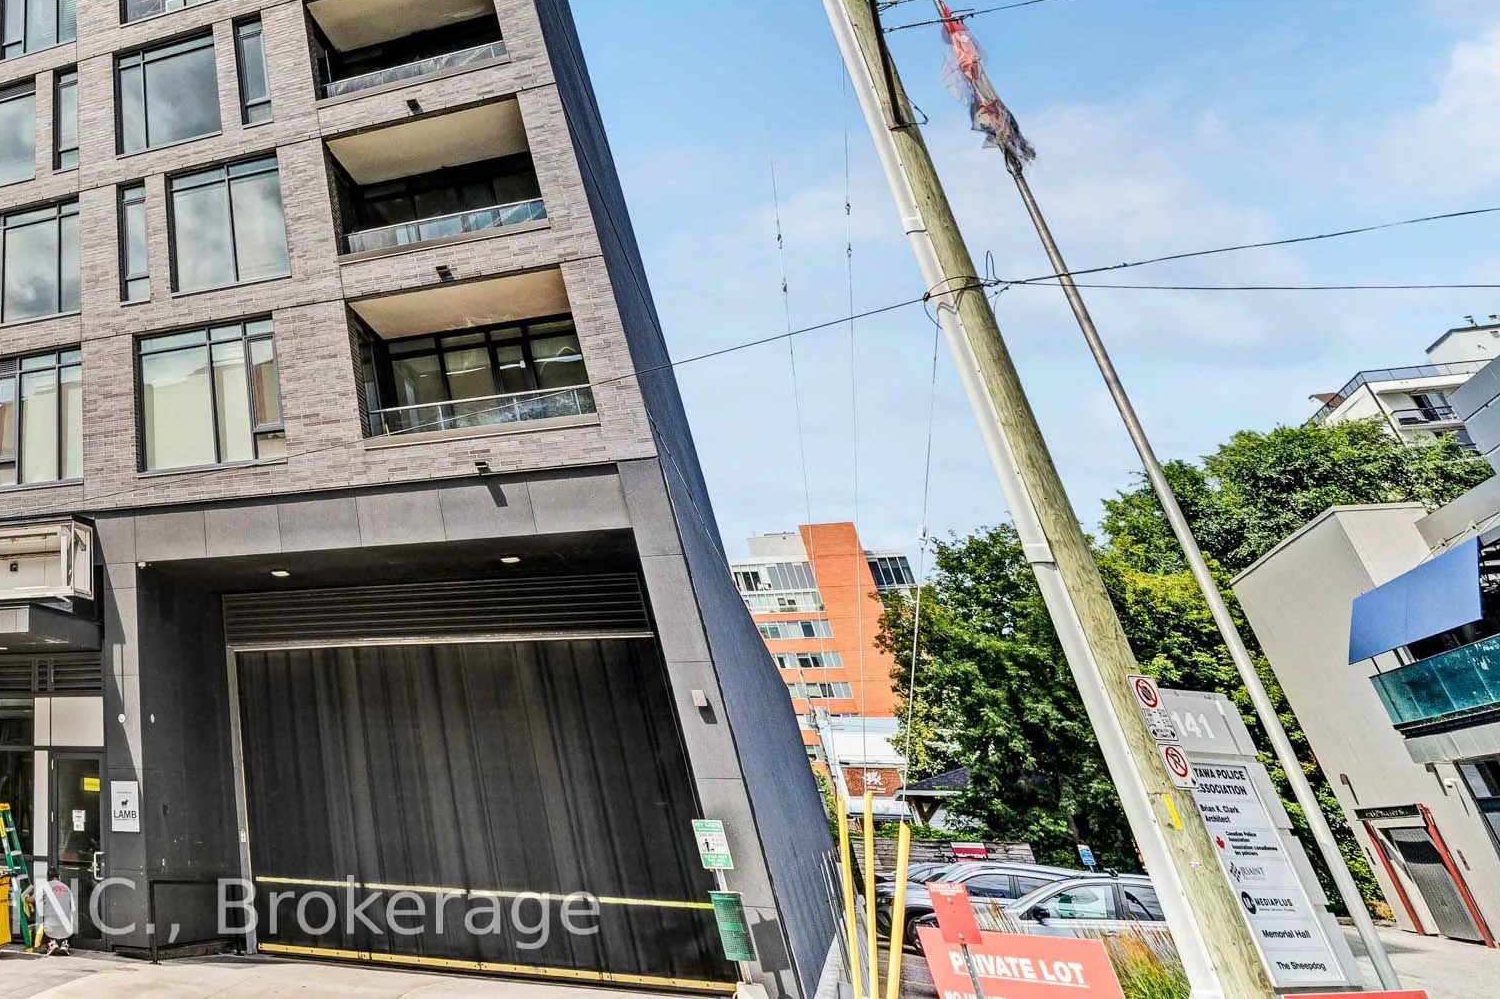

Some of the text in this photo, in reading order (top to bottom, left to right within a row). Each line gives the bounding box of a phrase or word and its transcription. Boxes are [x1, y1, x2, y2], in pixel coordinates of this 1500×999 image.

[1171, 711, 1215, 739] 141
[1193, 767, 1246, 781] TAWA POLICE
[1197, 783, 1248, 795] SSOCIATION
[113, 809, 137, 819] LAMB
[1254, 897, 1293, 907] MEDIAPLUS
[1261, 929, 1311, 939] Memorial Hall
[1038, 958, 1086, 985] LOT
[1276, 961, 1327, 972] The Sheepdog
